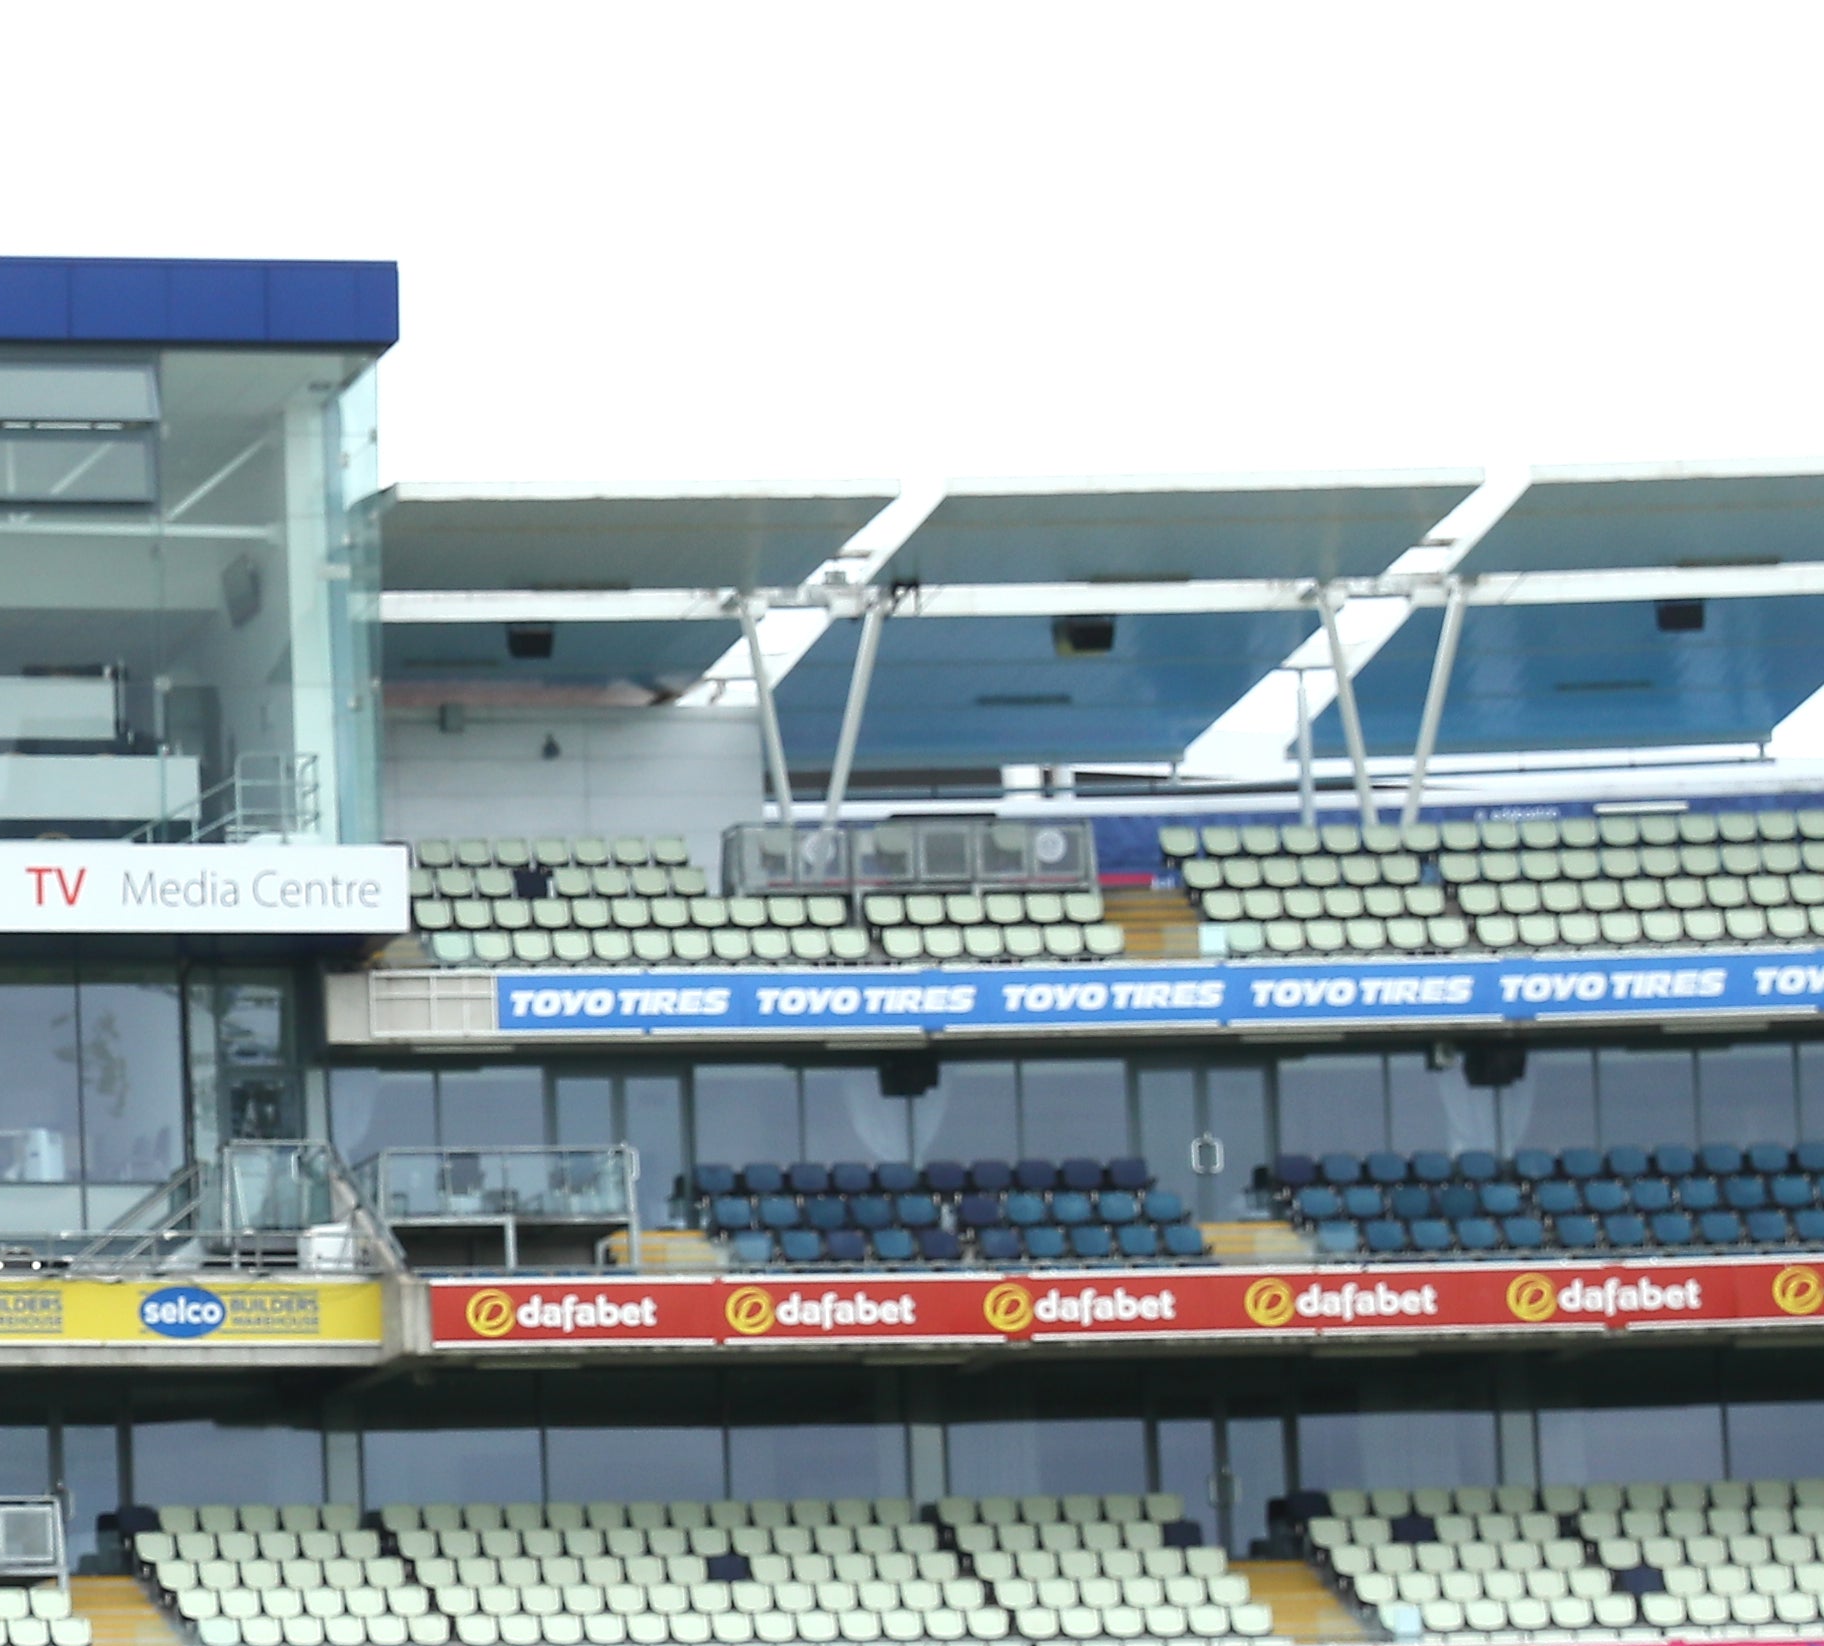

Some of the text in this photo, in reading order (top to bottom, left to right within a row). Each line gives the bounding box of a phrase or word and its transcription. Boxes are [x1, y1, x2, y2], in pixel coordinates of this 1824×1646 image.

[27, 867, 86, 906] TV
[122, 871, 239, 907] Media
[252, 870, 381, 908] Centre
[510, 987, 730, 1018] TOYO TIRES
[757, 985, 977, 1016] TOYO TIRES
[1003, 981, 1225, 1012] TOYO TIRES
[1251, 977, 1473, 1008] TOYO TIRES
[1501, 969, 1727, 1002] TOYO TIRES
[142, 1300, 222, 1325] selco
[517, 1295, 656, 1332] dafabet
[776, 1292, 915, 1329] dafabet
[1034, 1288, 1175, 1326] dafabet
[1295, 1283, 1437, 1321] dafabet
[1558, 1278, 1700, 1316] dafabet
